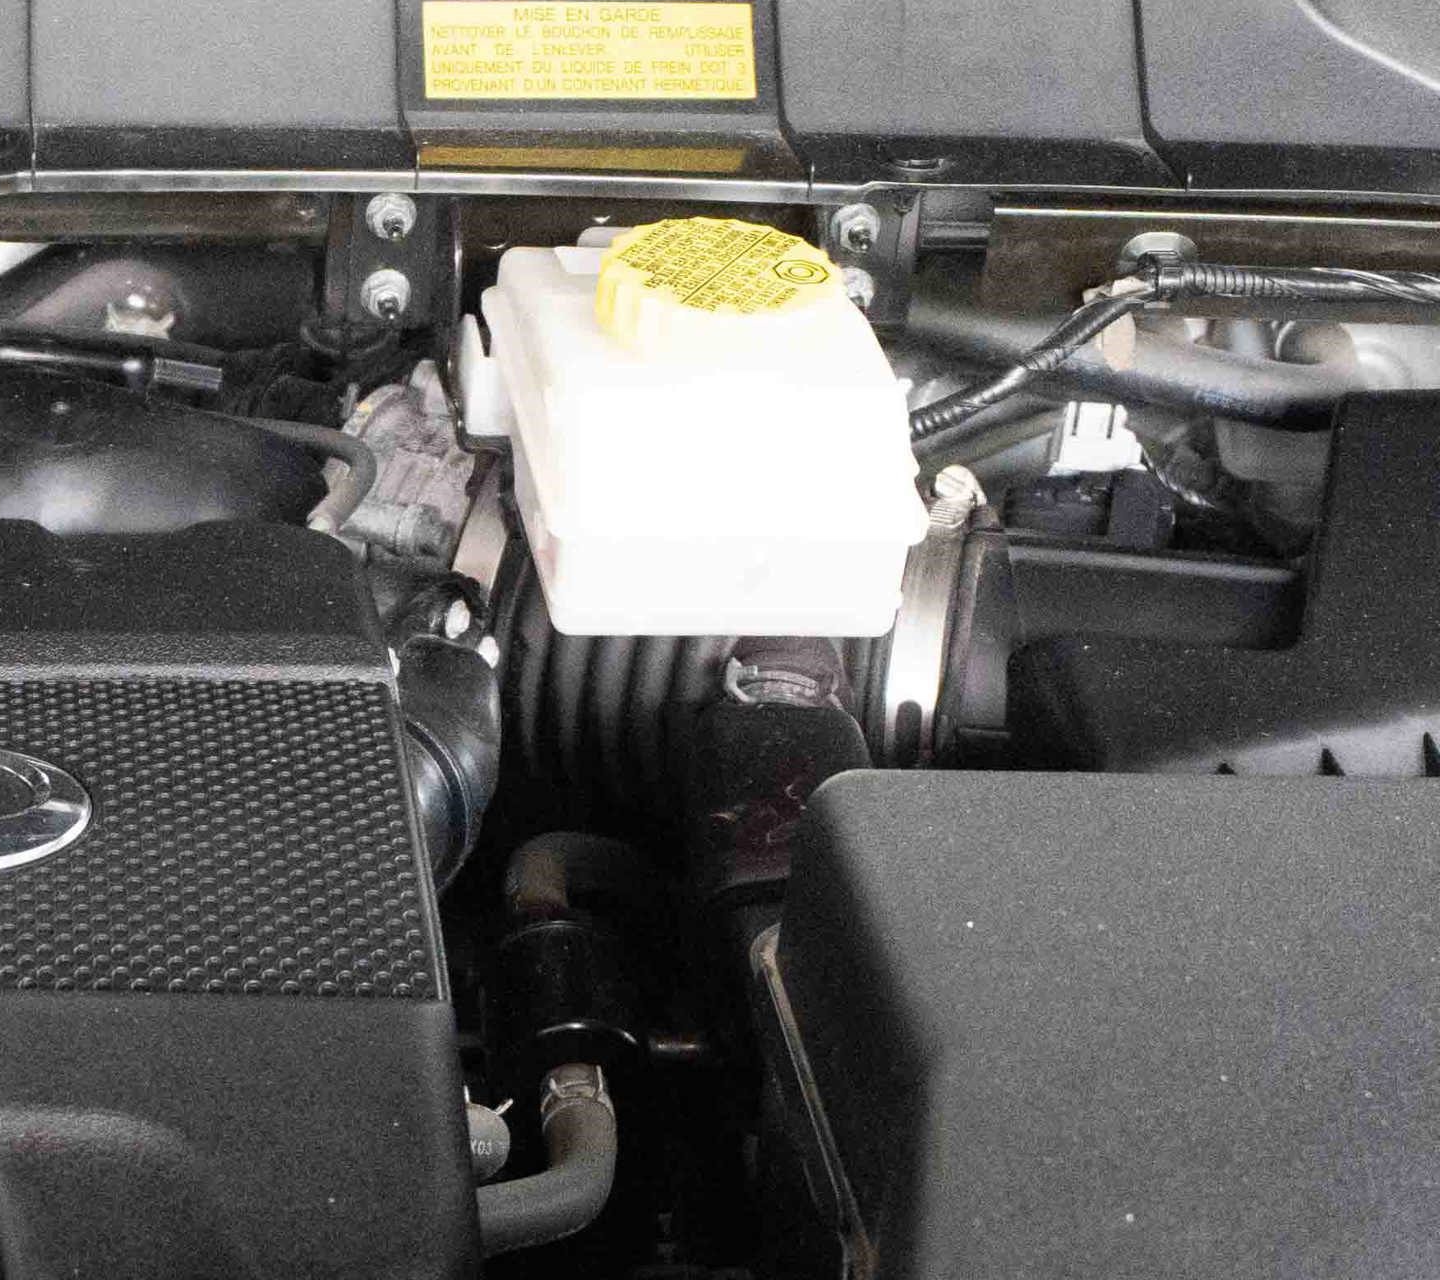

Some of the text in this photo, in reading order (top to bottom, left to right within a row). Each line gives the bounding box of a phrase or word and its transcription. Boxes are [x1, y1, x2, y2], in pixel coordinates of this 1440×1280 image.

[513, 7, 662, 22] MISE EN GARDE
[541, 26, 611, 39] BOUCHON
[620, 26, 639, 39] DE
[431, 60, 524, 74] UNIQUEMENT
[532, 60, 552, 74] DU
[560, 60, 616, 74] LIQUIDE
[623, 61, 642, 74] DE
[650, 61, 691, 74] FREIN
[700, 61, 727, 74] DOT
[432, 78, 515, 92] PROVENANT
[562, 78, 646, 92] CONTENANT
